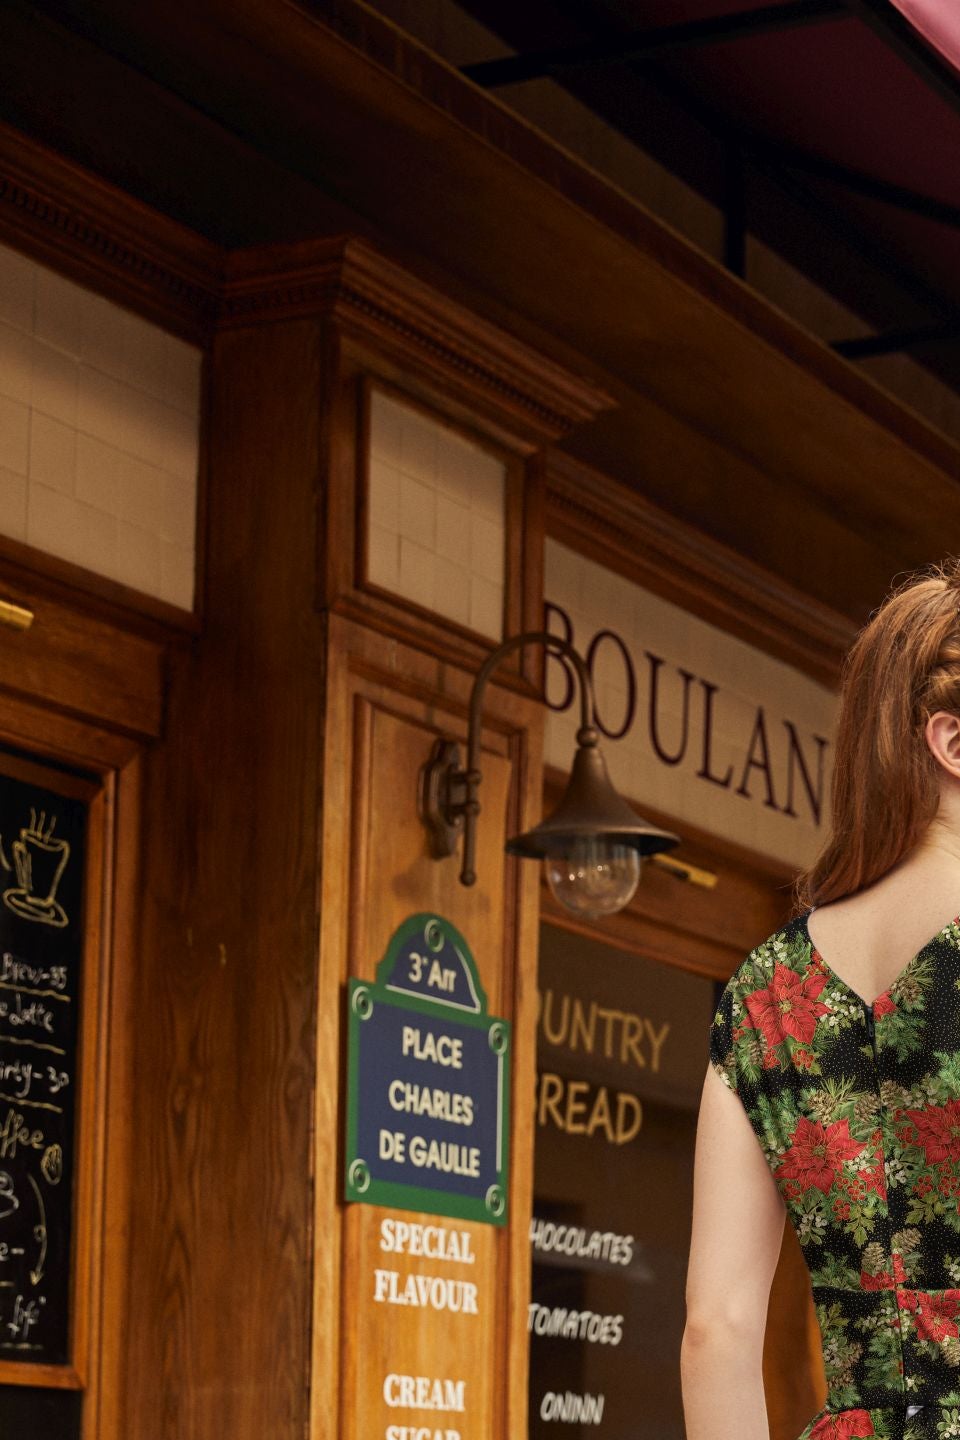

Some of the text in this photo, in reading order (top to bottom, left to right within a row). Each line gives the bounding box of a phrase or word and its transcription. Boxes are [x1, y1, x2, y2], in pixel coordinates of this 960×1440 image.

[402, 1026, 464, 1070] PLACE
[388, 1079, 474, 1126] CHARLES
[379, 1129, 481, 1178] DE GAULLE
[380, 1218, 476, 1264] SPECIAL
[374, 1269, 478, 1315] FLAVOUR
[527, 1303, 624, 1346] TOMATOES
[383, 1373, 466, 1412] CREAM
